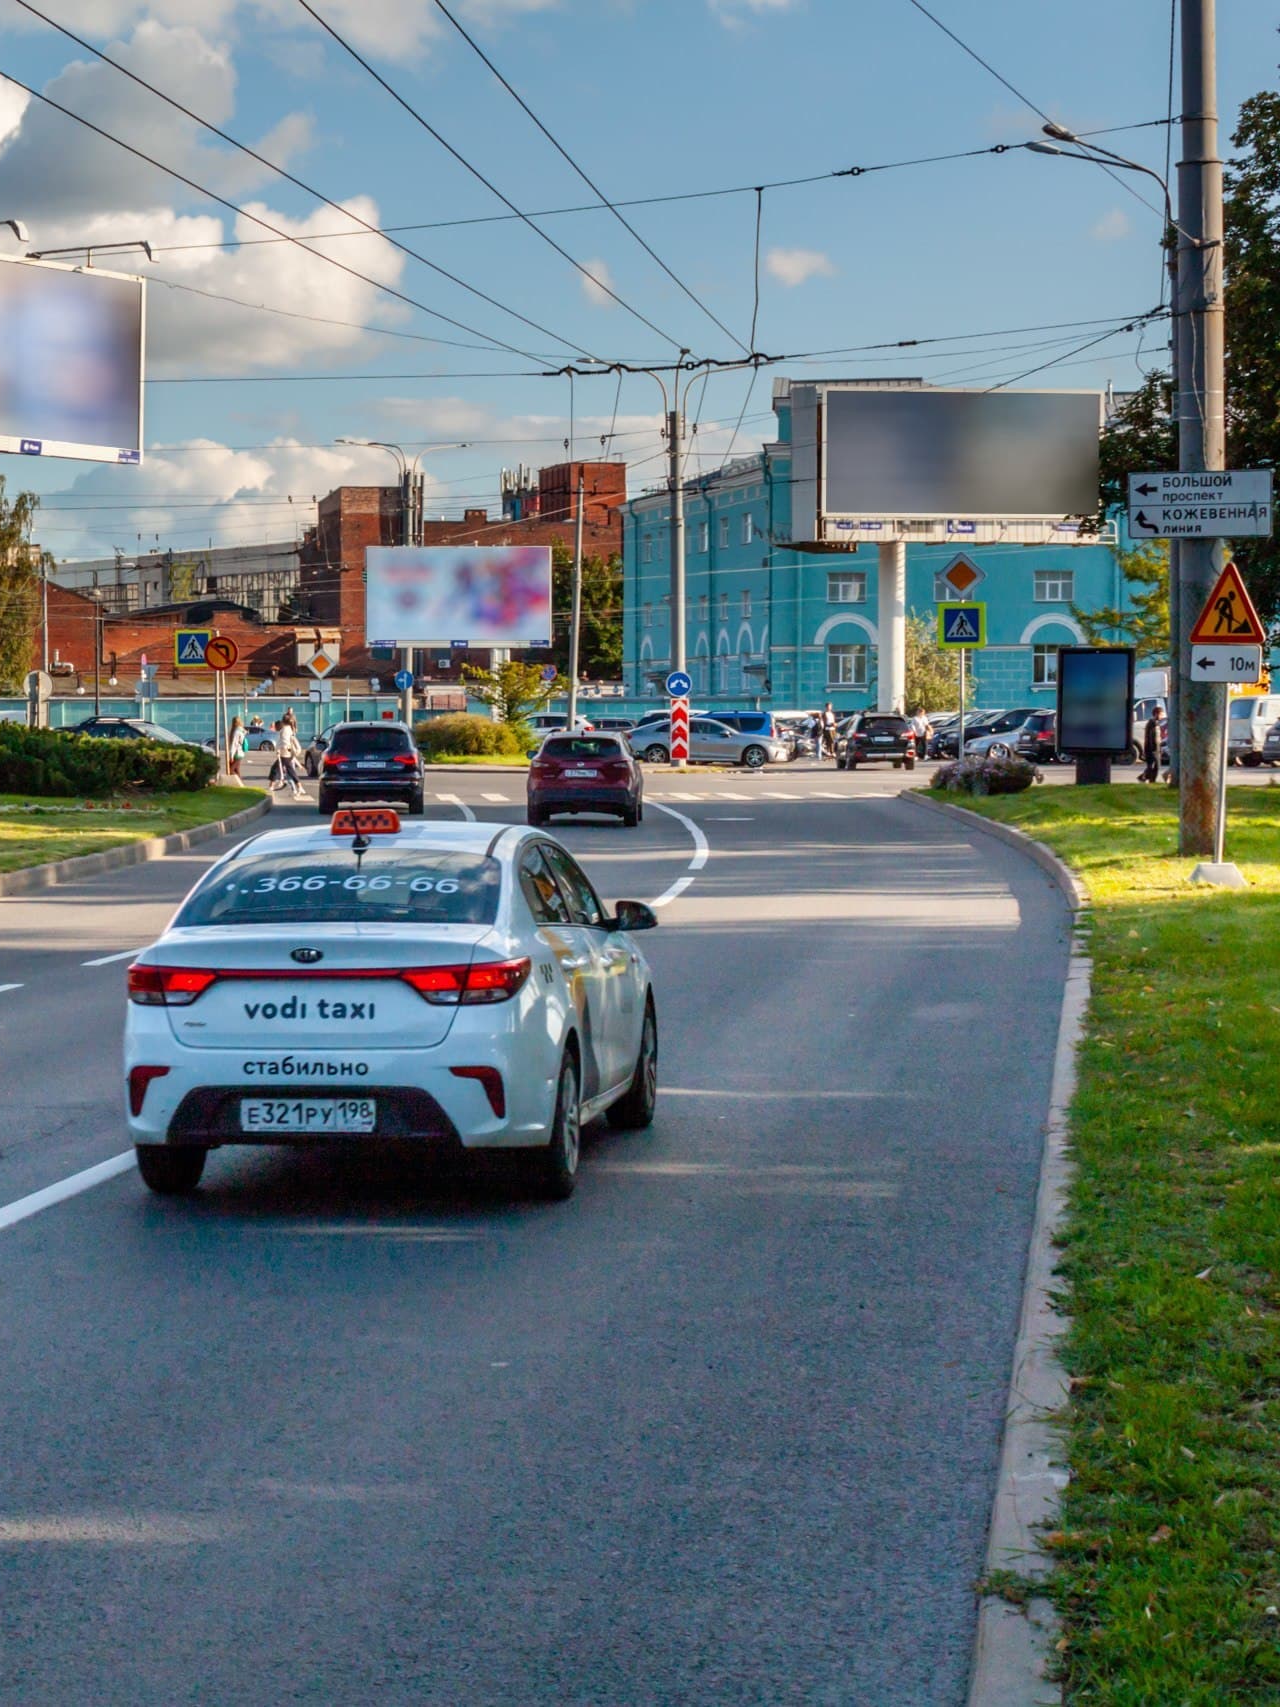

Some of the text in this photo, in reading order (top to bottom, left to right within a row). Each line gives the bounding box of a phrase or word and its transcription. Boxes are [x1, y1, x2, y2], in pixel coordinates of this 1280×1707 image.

[1162, 473, 1233, 488] БОЛЬШОЙ
[1162, 491, 1224, 504] проспект
[1162, 507, 1267, 520] КОЖЕВЕННАЯ
[244, 995, 376, 1020] vodi taxi
[243, 1055, 369, 1076] стабильно
